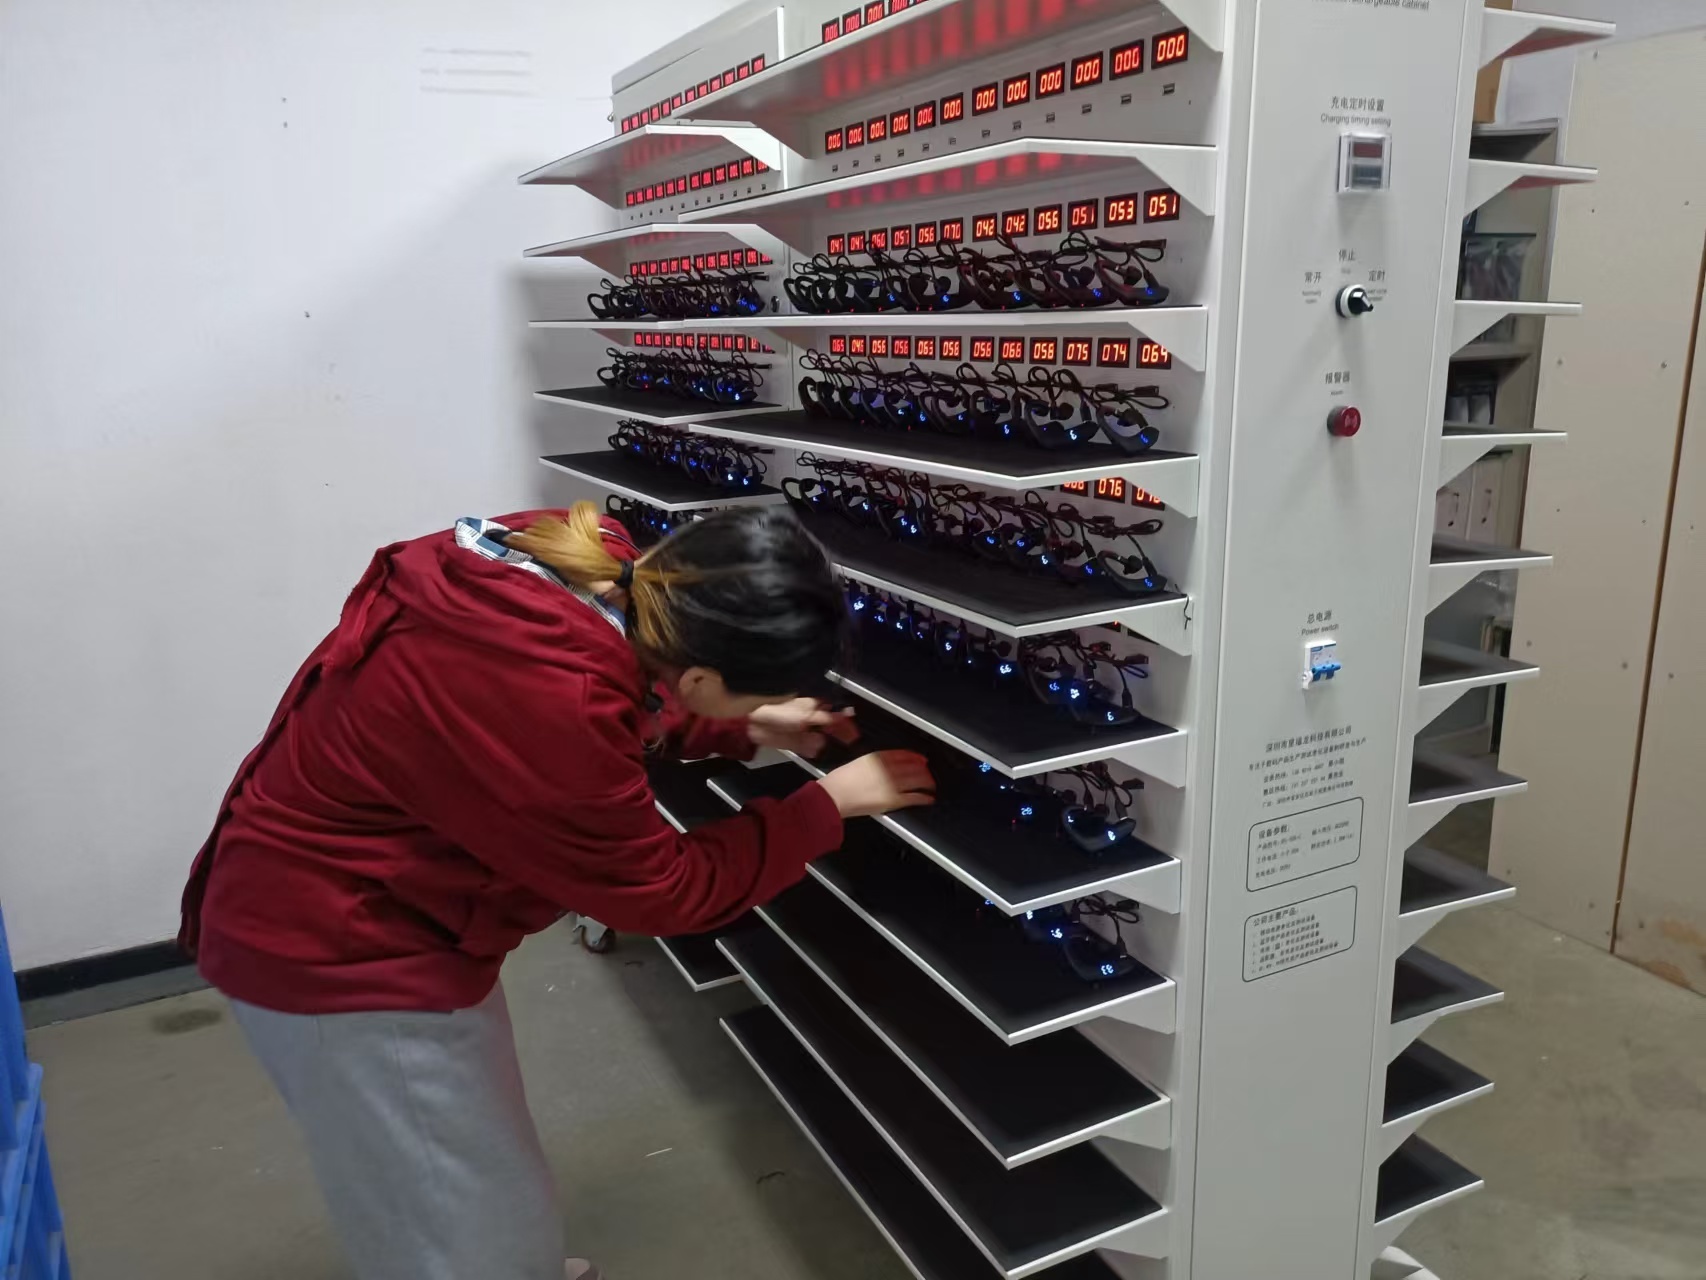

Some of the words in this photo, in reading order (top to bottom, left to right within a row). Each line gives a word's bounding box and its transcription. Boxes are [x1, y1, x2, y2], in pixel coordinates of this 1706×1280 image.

[868, 4, 882, 24] 000
[944, 100, 961, 119] 000
[976, 89, 995, 110] 000
[1007, 80, 1027, 102] 000
[1040, 70, 1061, 93] 000
[1076, 59, 1099, 83] 000
[1115, 47, 1139, 73] 000
[1157, 35, 1184, 61] 000
[1331, 96, 1385, 112] 充电定时设置
[1320, 113, 1350, 125] Charging
[1351, 114, 1370, 125] timing
[1371, 115, 1391, 127] setting
[976, 219, 994, 237] 042
[1006, 215, 1025, 233] 042
[1038, 211, 1058, 230] 056
[1072, 207, 1094, 225] 051
[1109, 200, 1133, 221] 053
[1149, 196, 1176, 216] 051
[1338, 249, 1356, 262] 停止
[1304, 272, 1322, 284] 常开
[1368, 270, 1386, 282] 定时
[1034, 343, 1054, 359] 058
[1067, 344, 1088, 360] 075
[1102, 344, 1126, 361] 074
[1142, 344, 1167, 362] 064
[1325, 371, 1351, 385] 报警器
[1099, 478, 1122, 497] 076
[1307, 610, 1332, 624] 总电源
[1301, 627, 1320, 637] Power
[1321, 623, 1340, 634] switch
